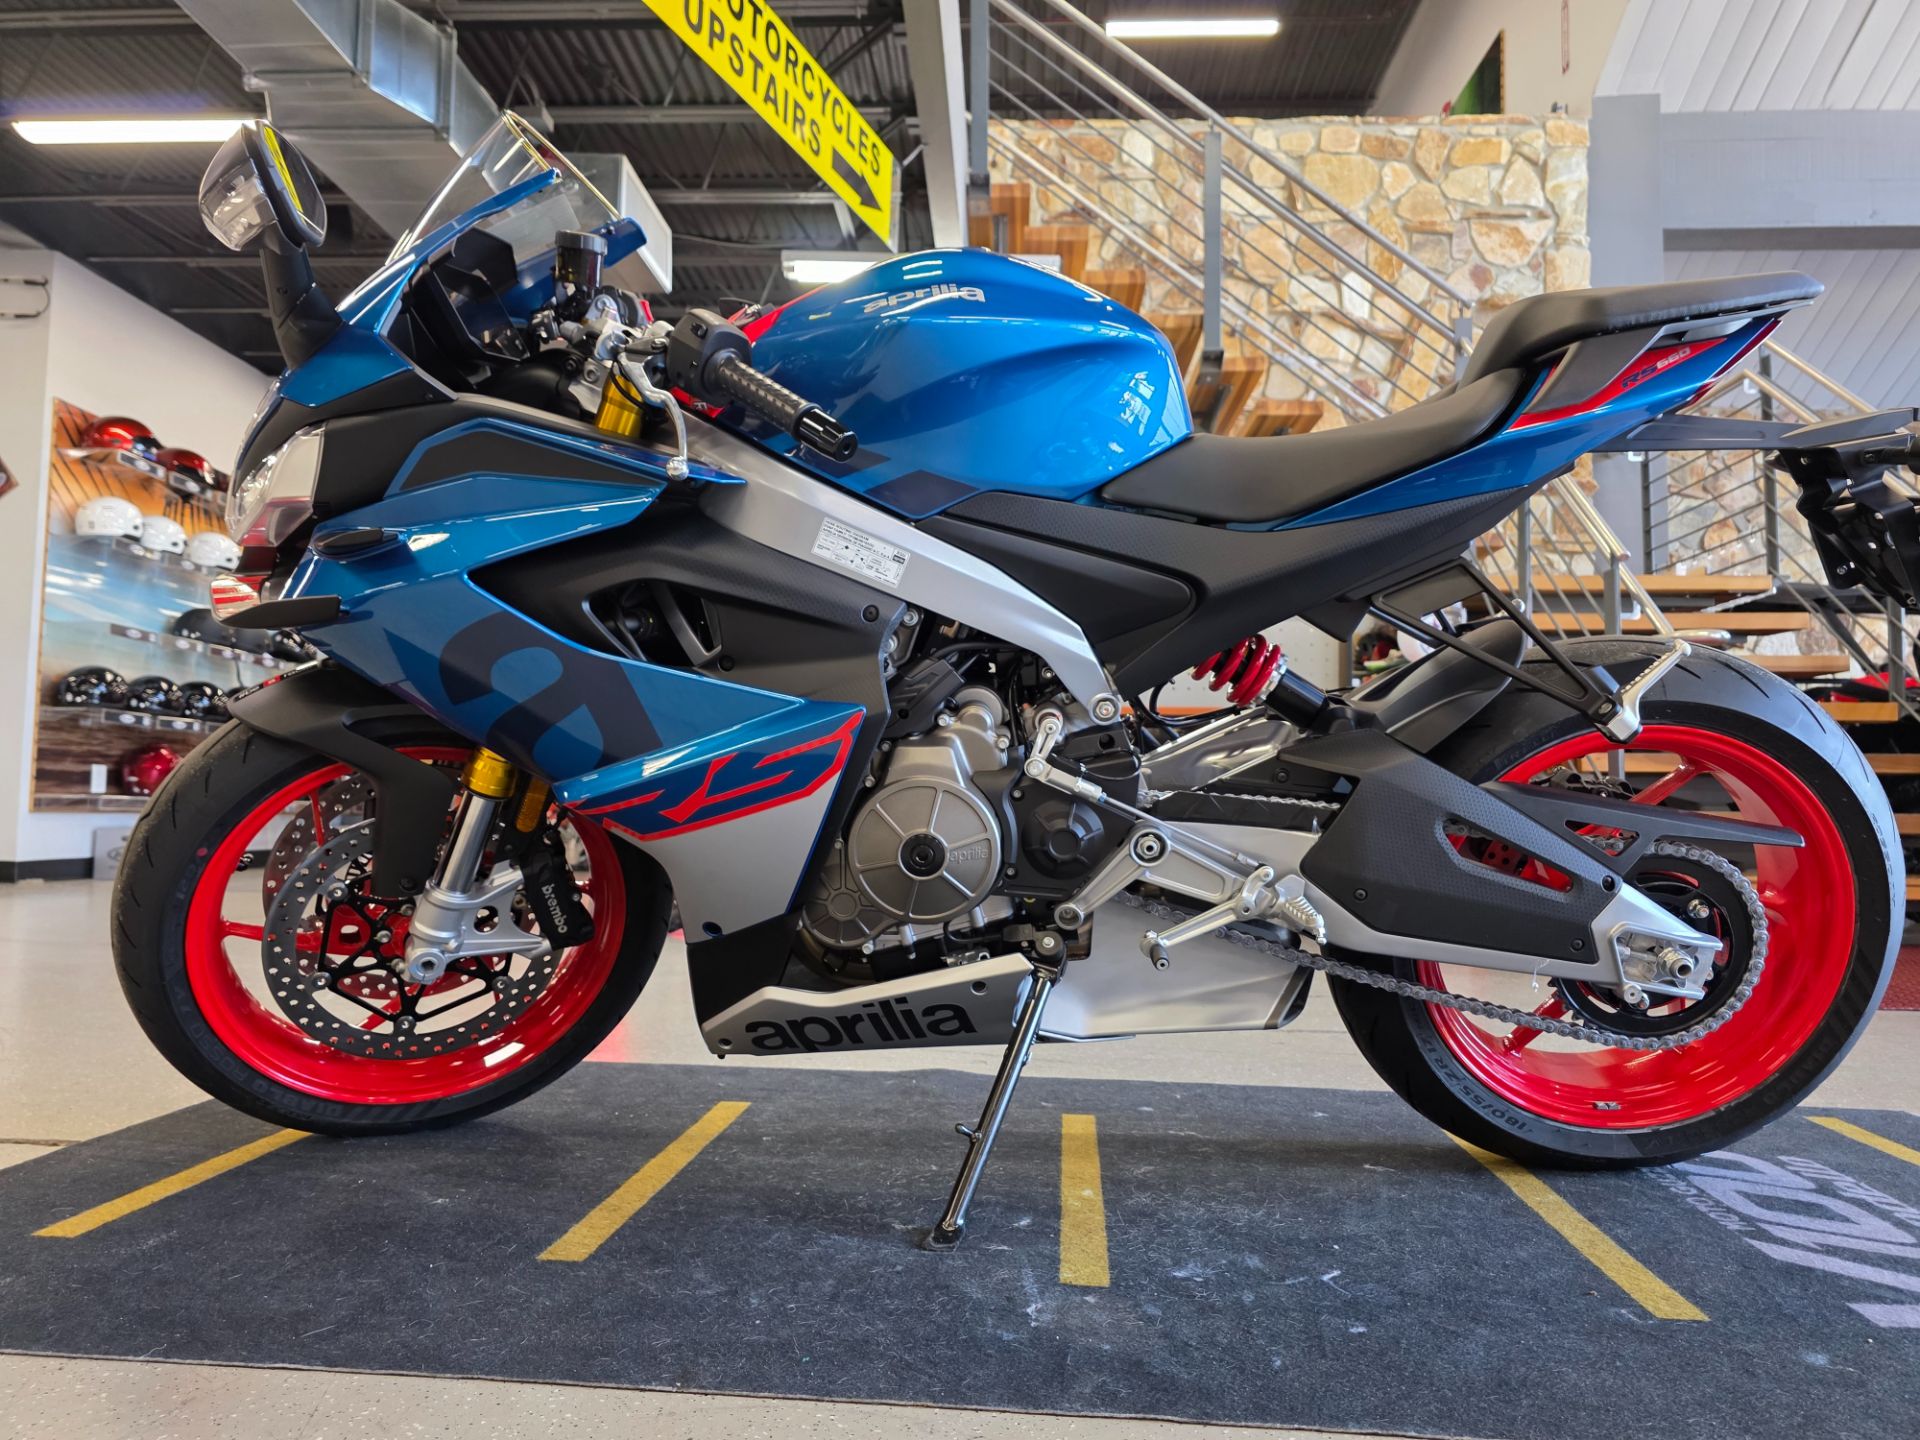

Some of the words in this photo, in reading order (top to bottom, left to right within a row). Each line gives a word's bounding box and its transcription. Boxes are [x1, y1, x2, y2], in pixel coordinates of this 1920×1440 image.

[684, 0, 820, 157] UPSTAIRS
[717, 0, 881, 176] TORCYCLES
[864, 284, 985, 313] aprilia
[949, 848, 990, 863] aprilia
[541, 884, 568, 933] brembo
[745, 997, 977, 1050] aprilia
